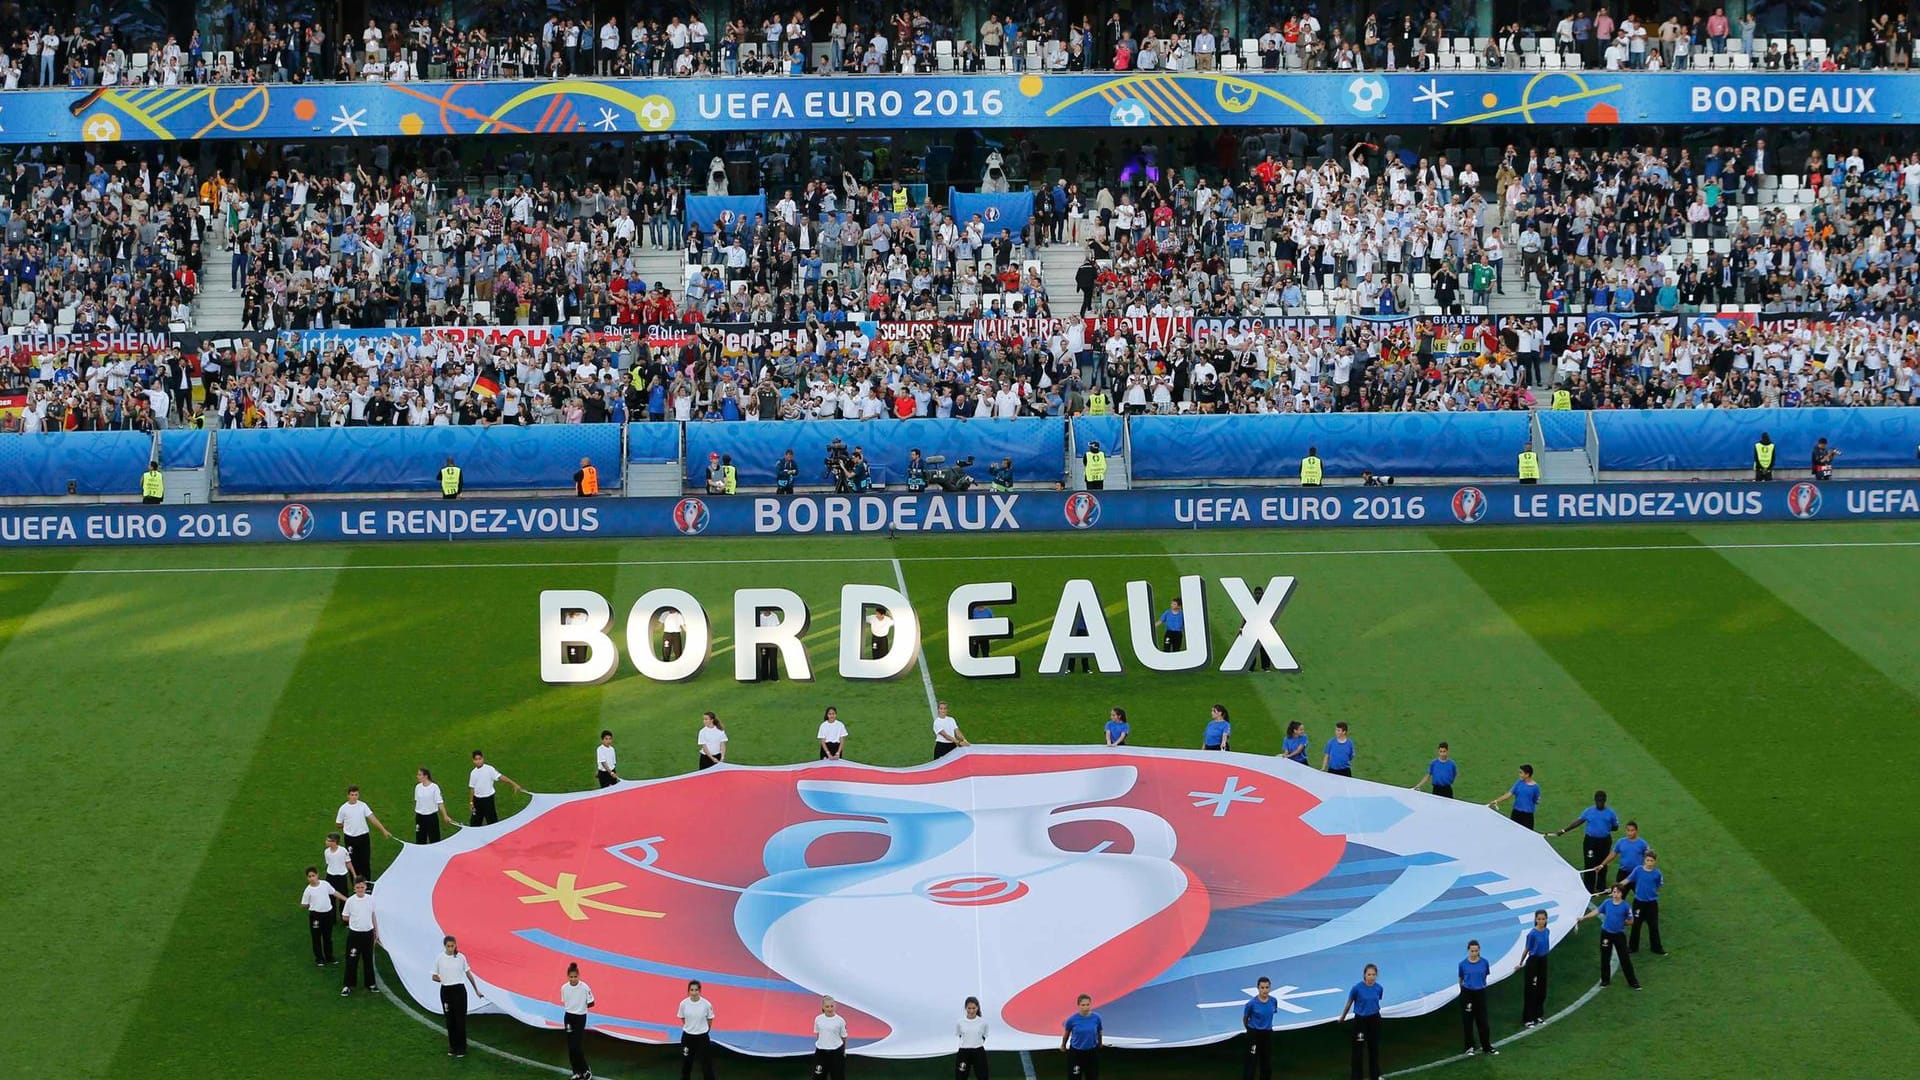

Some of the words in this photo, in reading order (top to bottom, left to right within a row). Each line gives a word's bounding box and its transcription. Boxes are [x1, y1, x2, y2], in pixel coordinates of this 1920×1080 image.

[699, 93, 794, 119] UEFA
[804, 91, 902, 117] EURO
[913, 89, 1003, 115] 2016
[1691, 86, 1876, 113] BORDEAUX
[603, 325, 634, 337] Adler
[647, 324, 689, 341] Adler
[1432, 315, 1479, 326] GRABEN
[18, 332, 165, 353] HEIDELSHEIM
[754, 494, 1020, 533] BORDEAUX
[1174, 497, 1250, 523] UEFA
[1260, 496, 1342, 521] EURO
[1352, 495, 1426, 520] 2016
[1513, 494, 1549, 518] LE
[1558, 490, 1763, 516] RENDEZ-VOUS
[1846, 489, 1920, 513] UEFA
[1, 516, 76, 540] UEFA
[86, 514, 167, 538] EURO
[177, 513, 252, 537] 2016
[340, 510, 377, 535] LE
[387, 507, 599, 534] RENDEZ-VOUS
[540, 576, 1301, 684] BORDEAUX
